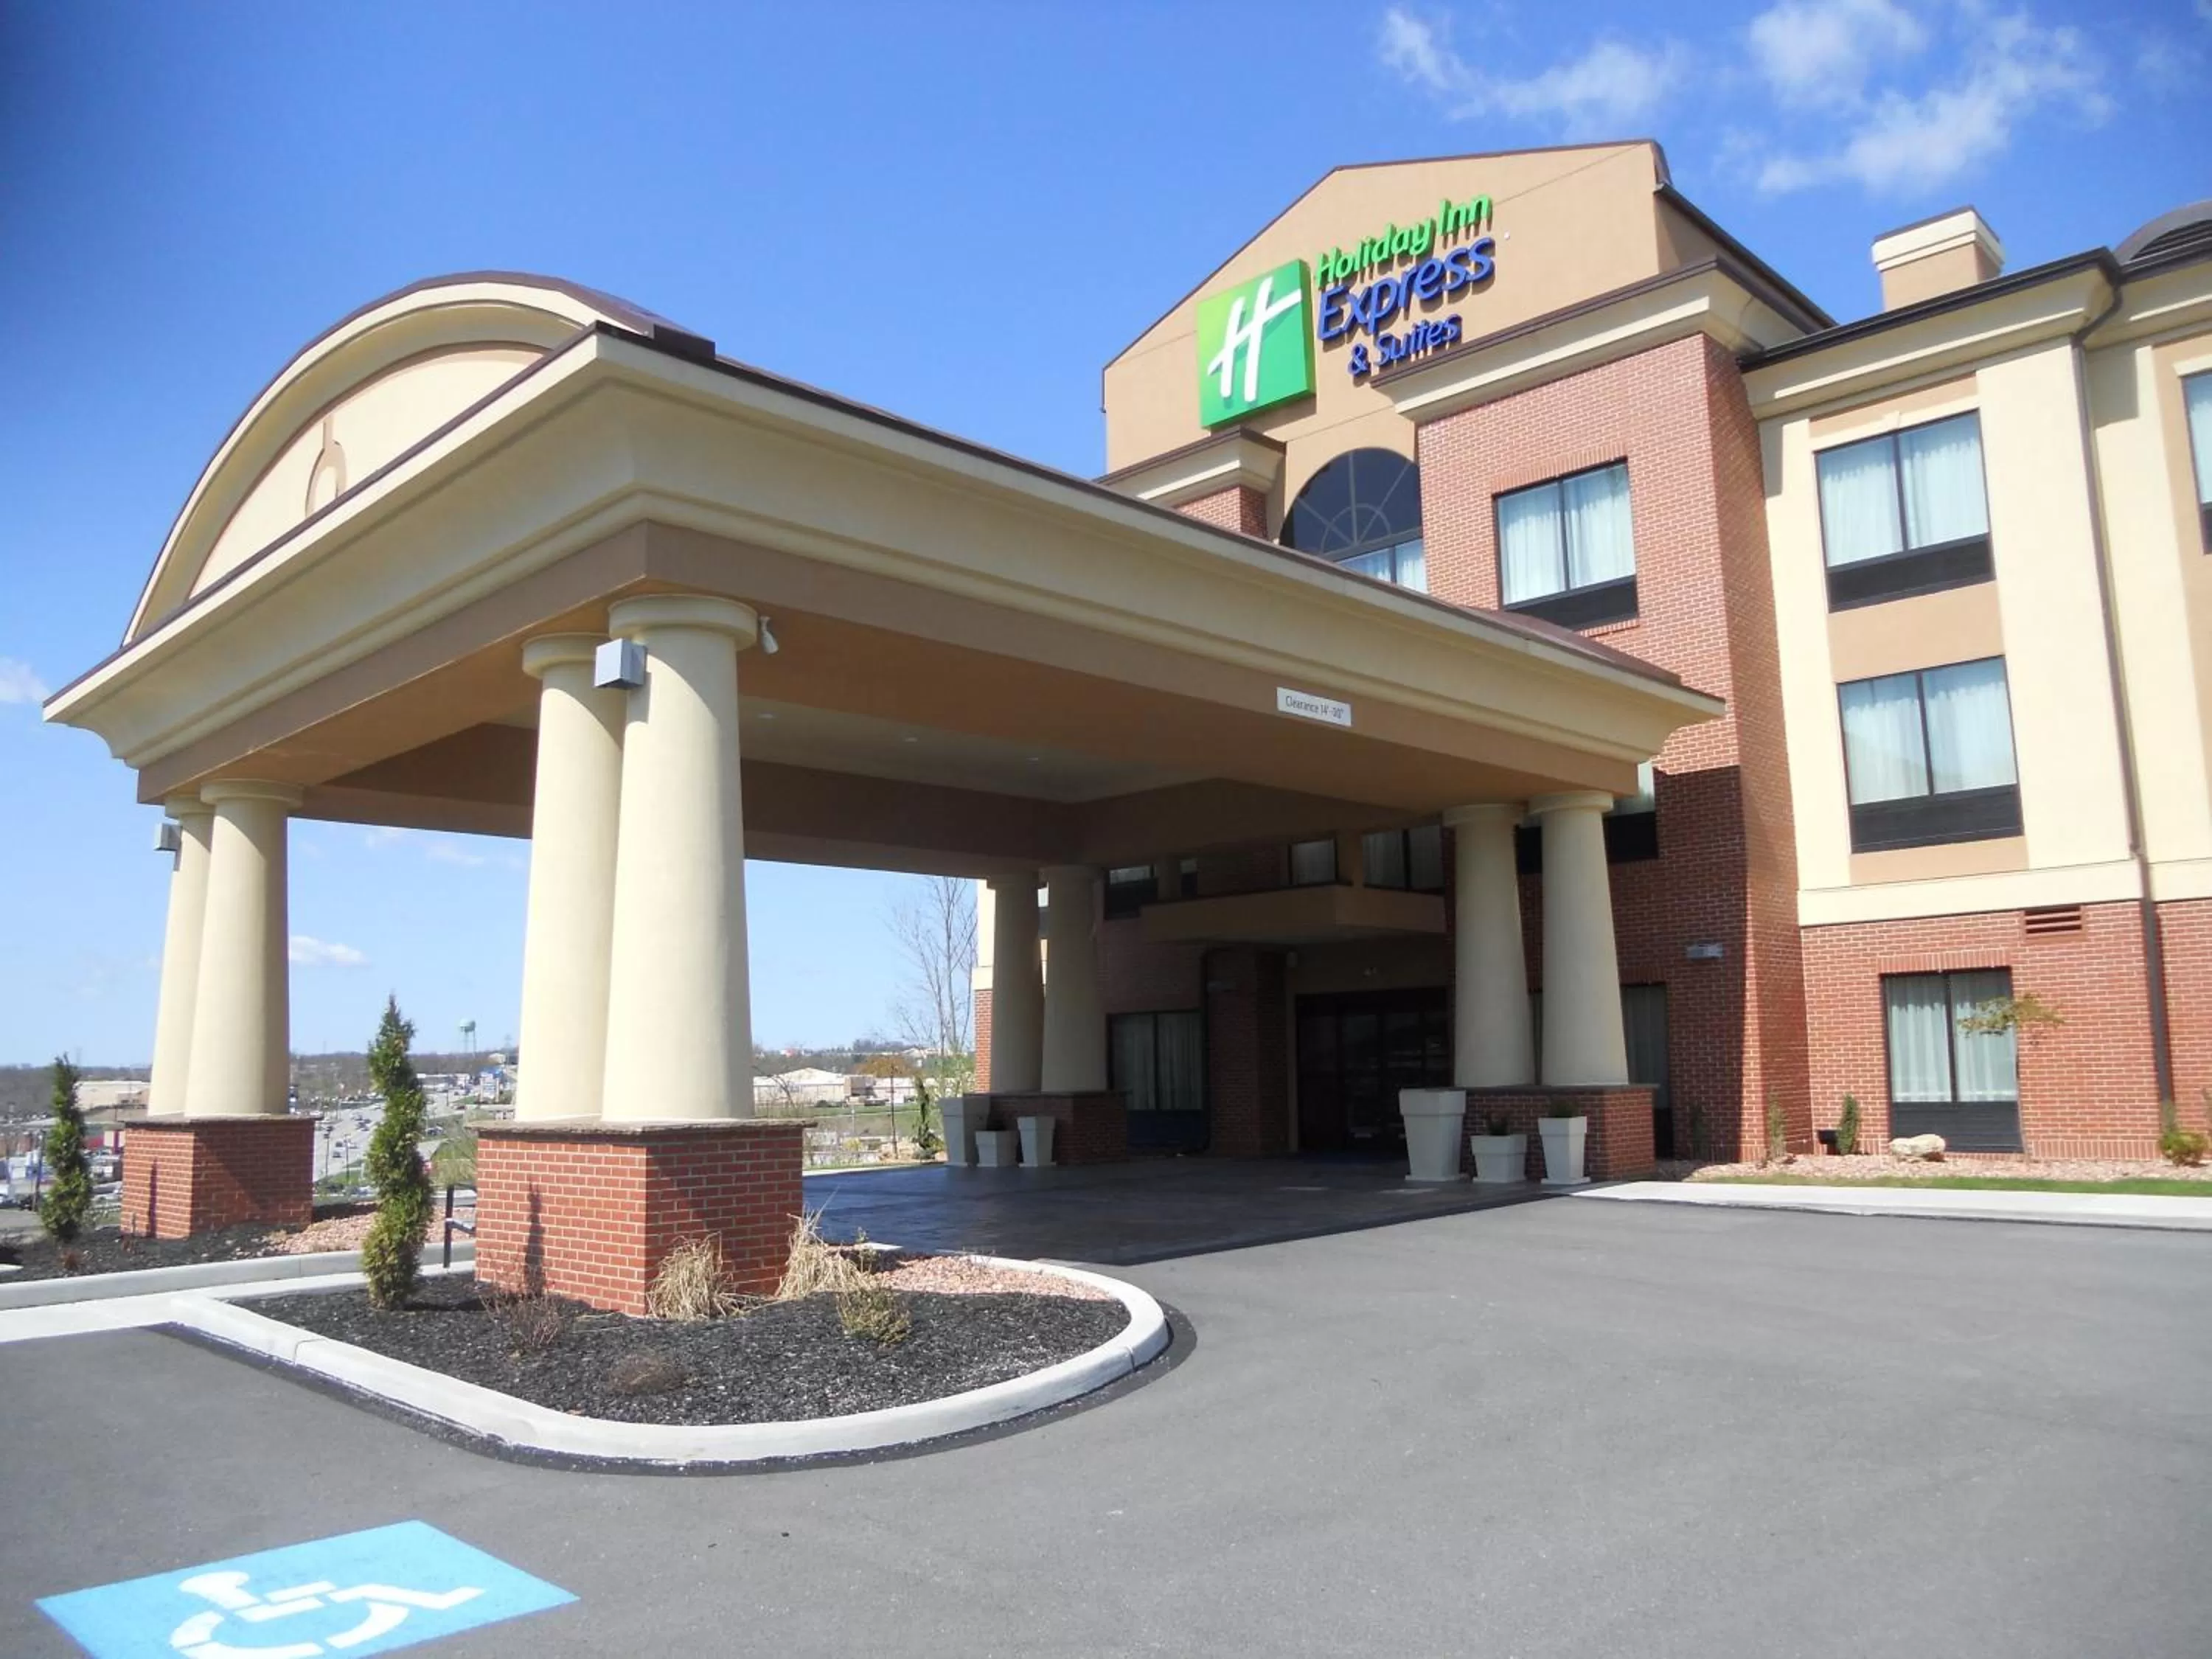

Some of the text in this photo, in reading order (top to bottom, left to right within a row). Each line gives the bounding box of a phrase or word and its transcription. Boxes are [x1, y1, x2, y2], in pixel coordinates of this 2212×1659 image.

[1315, 195, 1492, 288] Holiday Inn
[1318, 237, 1495, 340] Express
[1348, 313, 1463, 377] & Suites
